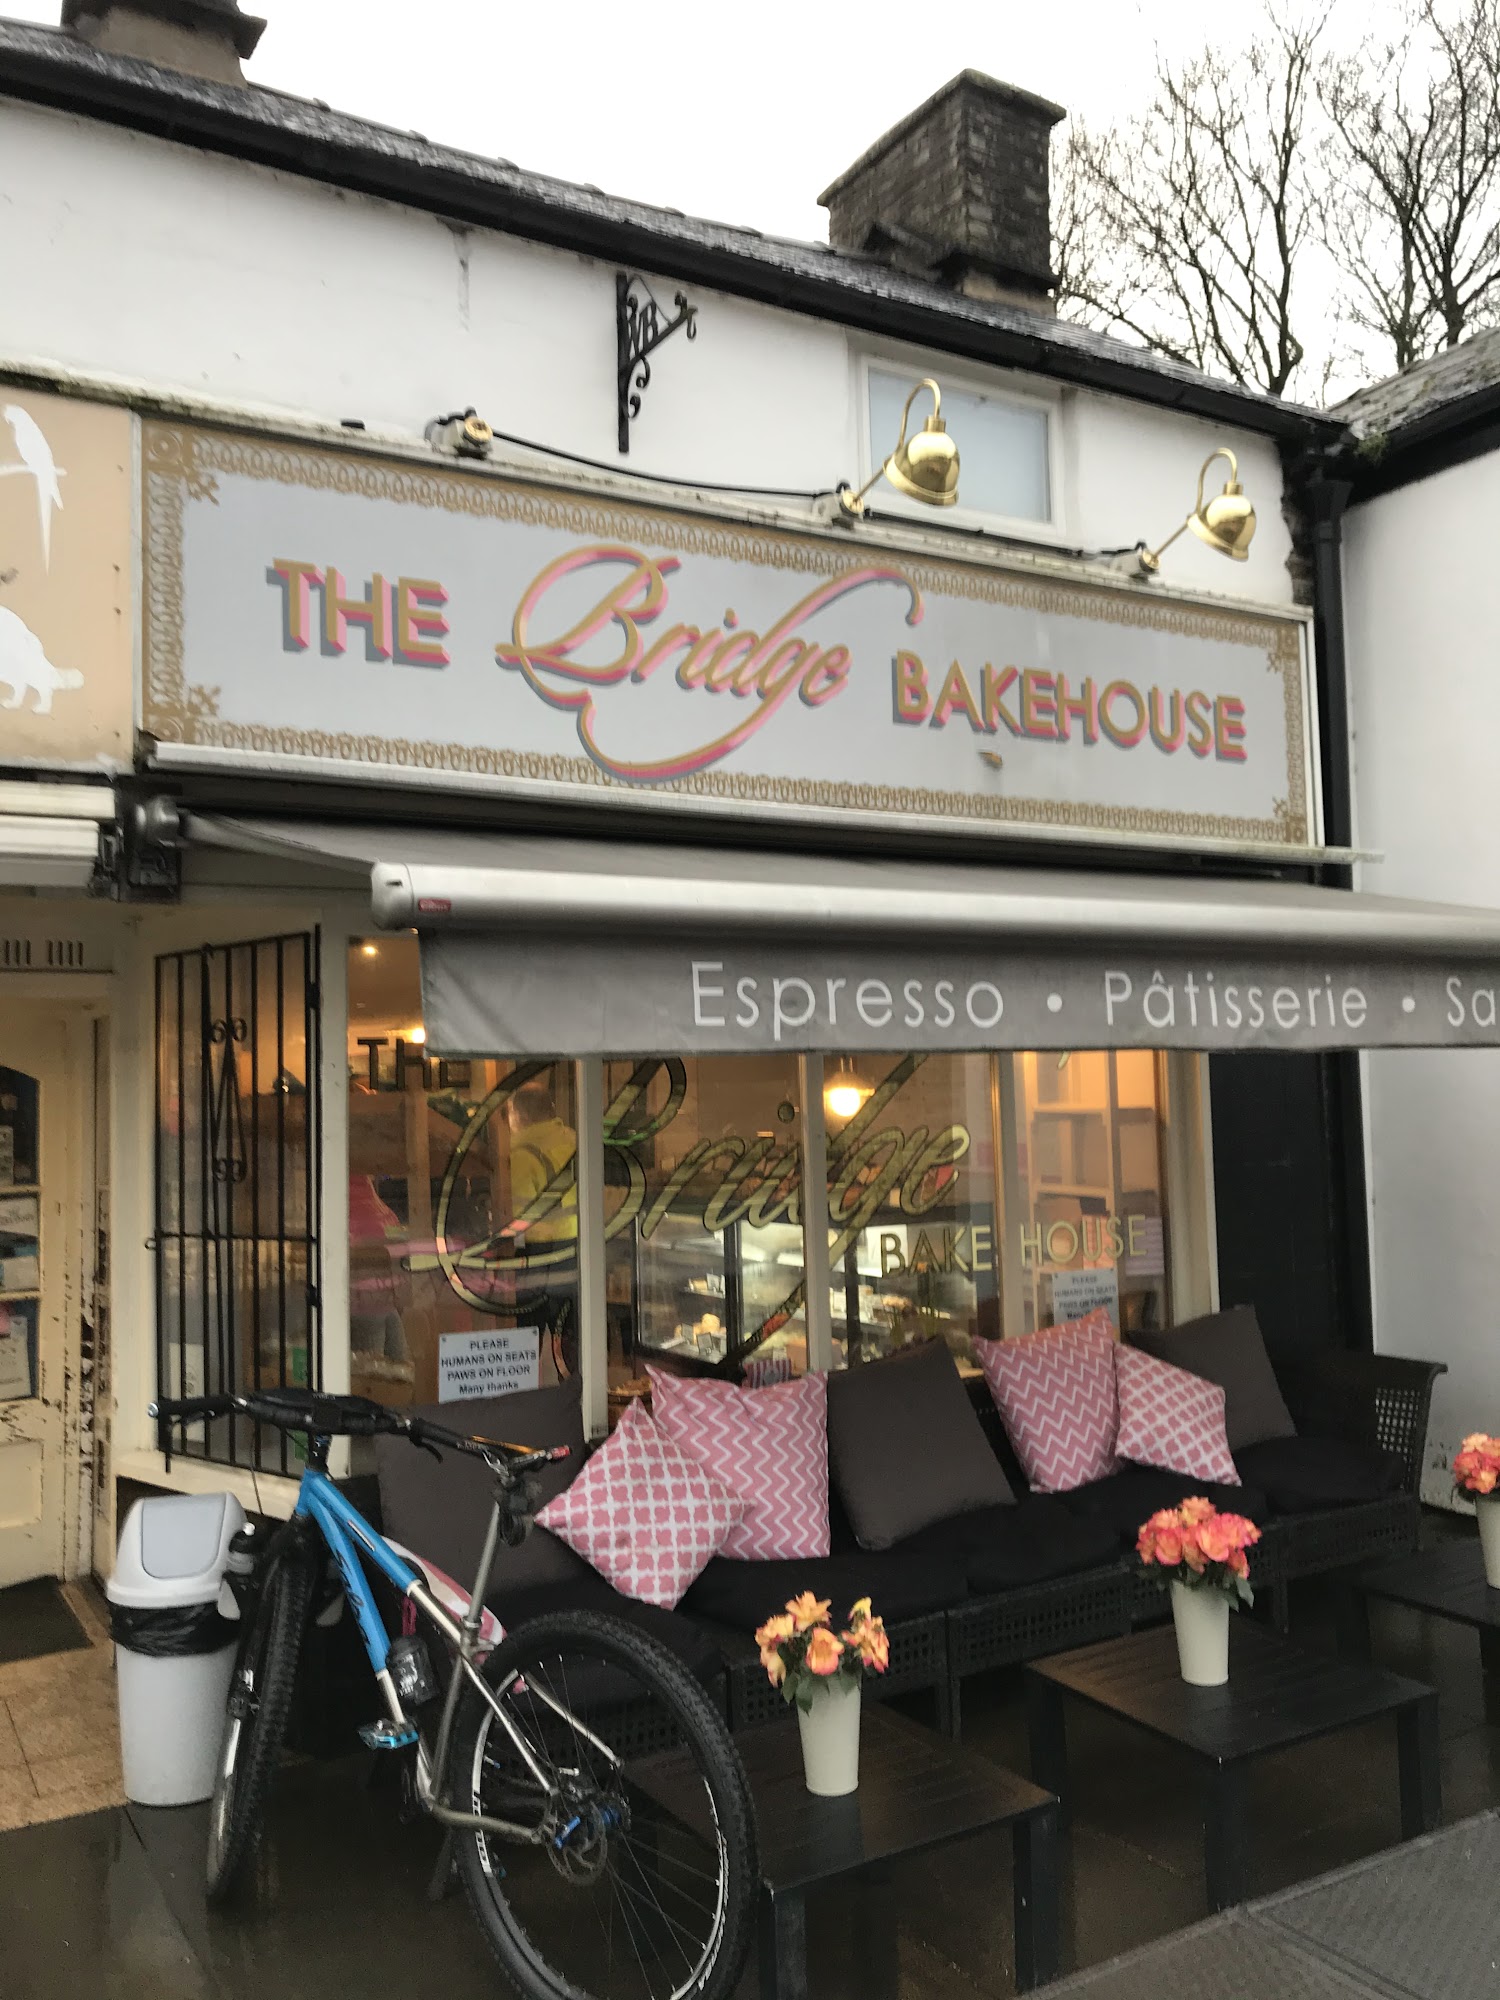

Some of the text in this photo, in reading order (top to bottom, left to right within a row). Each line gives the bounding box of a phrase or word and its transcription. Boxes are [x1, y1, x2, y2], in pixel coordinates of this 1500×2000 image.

[267, 542, 1248, 784] THE Bridge BAKEHOUSE
[691, 961, 1496, 1042] Espresso Pâtisserie Sa
[880, 1213, 1147, 1279] BAKE HOUSE
[470, 1337, 510, 1351] PLEASE
[441, 1349, 537, 1368] HUMANS ON SEATS
[447, 1363, 531, 1382] PAWS ON FLOOR
[459, 1380, 519, 1396] Many thanks
